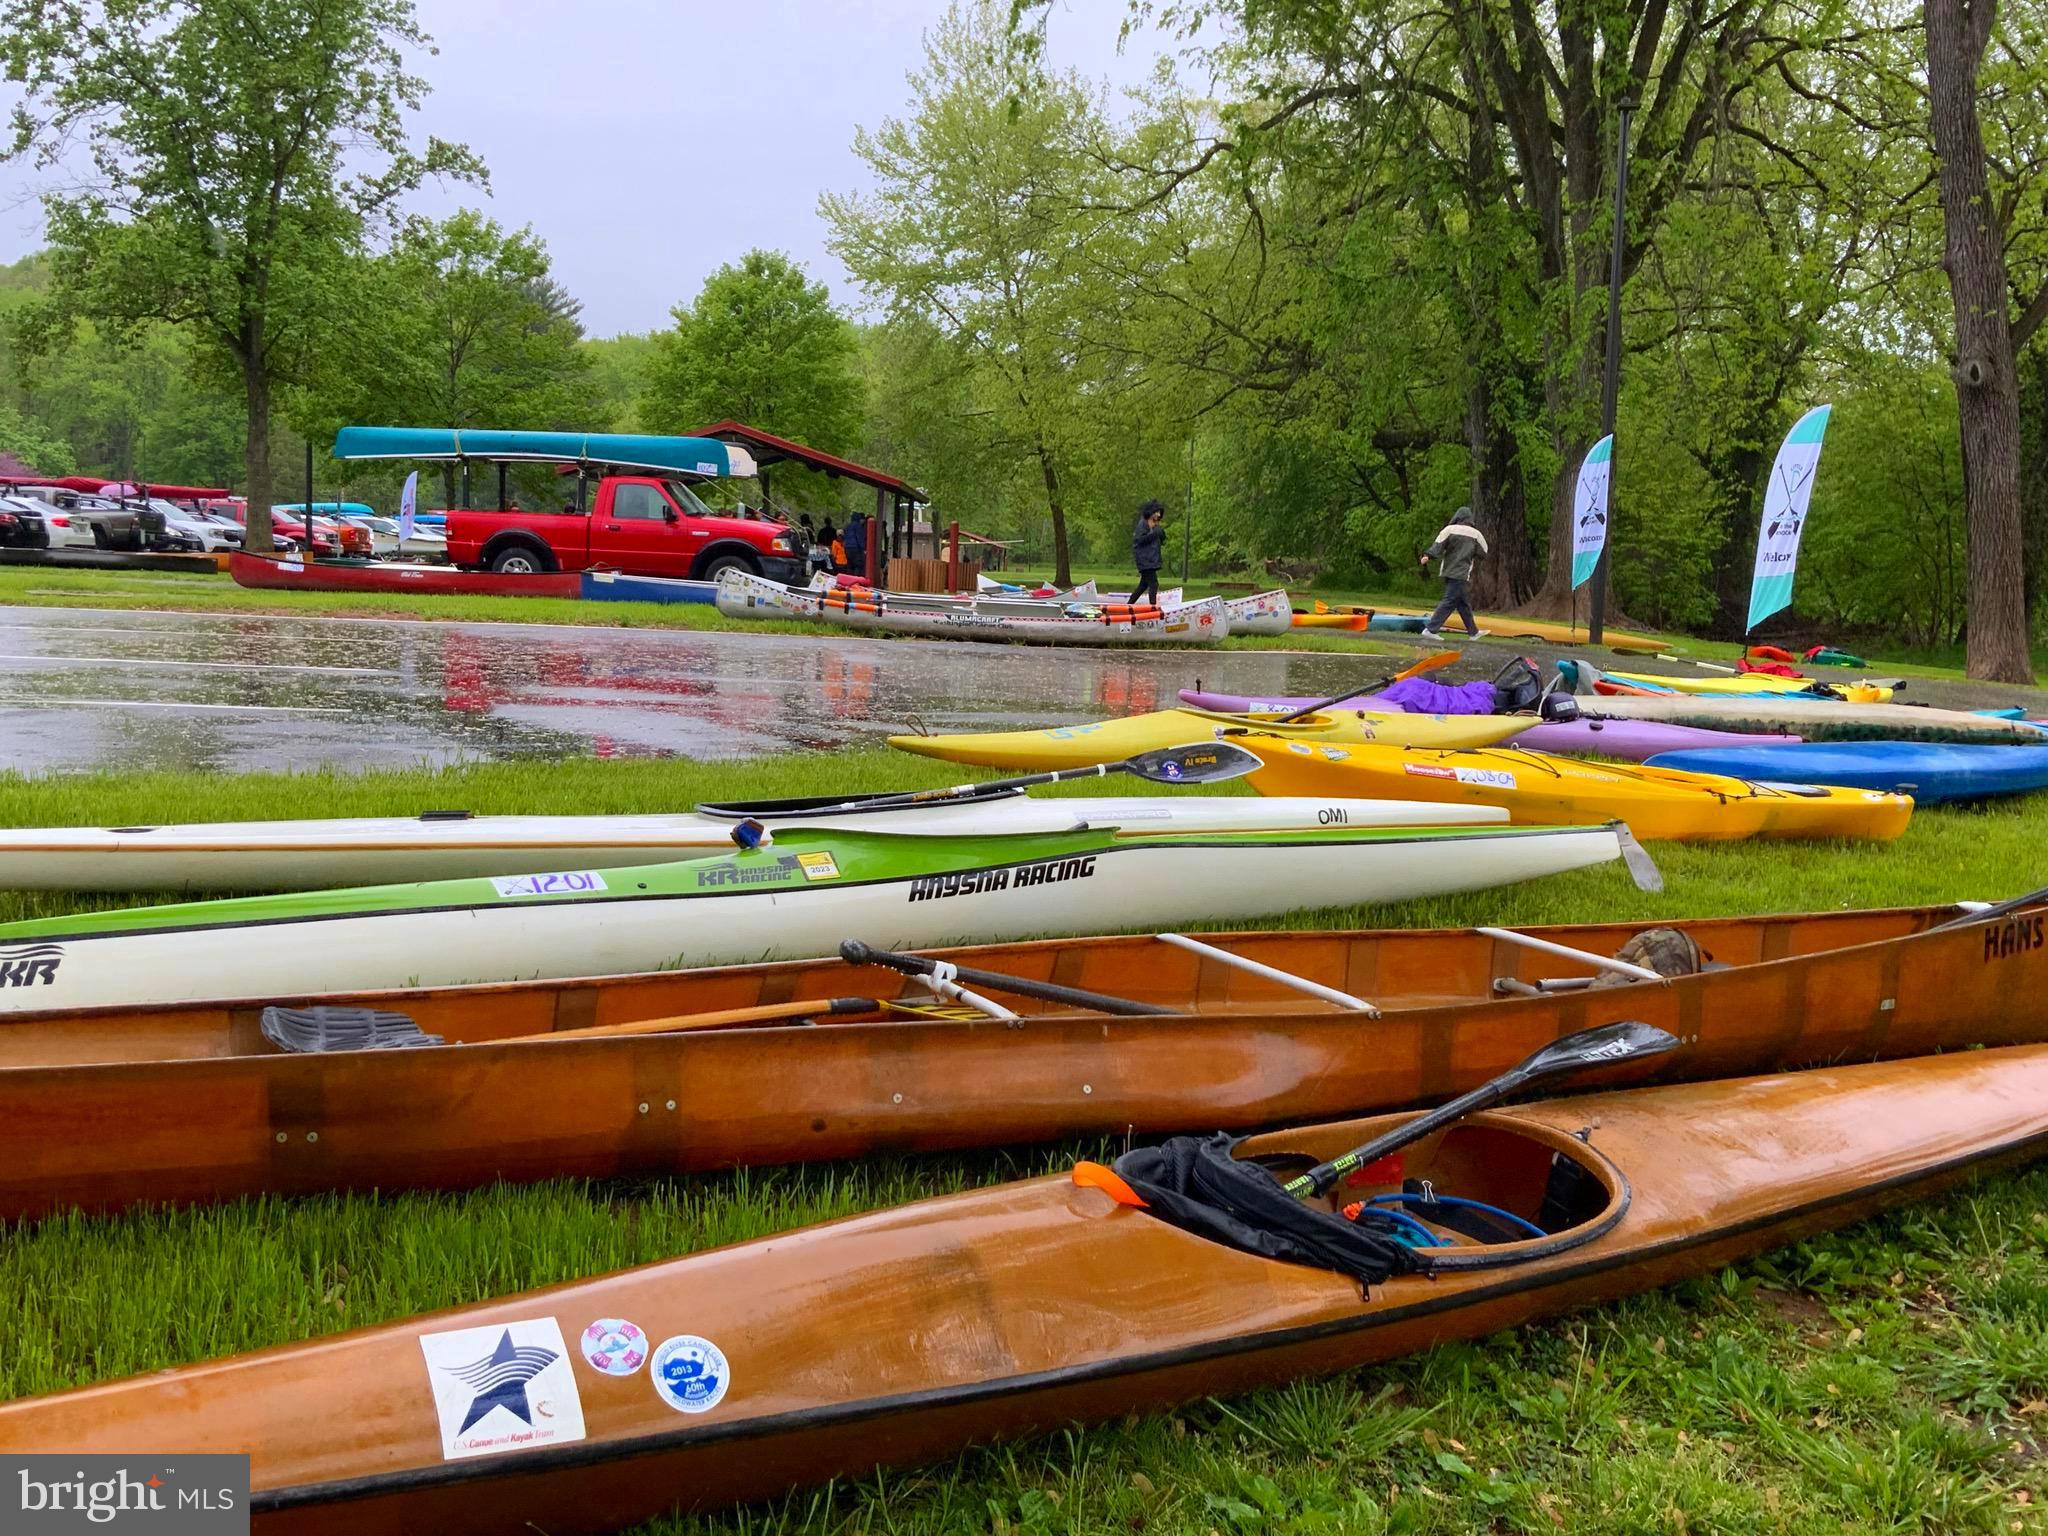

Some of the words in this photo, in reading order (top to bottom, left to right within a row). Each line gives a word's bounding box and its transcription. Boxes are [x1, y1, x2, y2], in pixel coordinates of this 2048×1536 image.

[1318, 807, 1348, 825] OMI
[698, 868, 739, 887] KR
[741, 871, 792, 885] RACING
[811, 865, 831, 874] 2023
[908, 869, 1009, 902] KNYSNA
[1013, 856, 1097, 888] RACING
[1983, 915, 2044, 964] HANS
[0, 959, 61, 988] KR
[670, 1364, 693, 1376] 2013
[685, 1382, 706, 1393] 60th
[469, 1438, 494, 1449] Canoe
[494, 1435, 510, 1445] and
[511, 1431, 533, 1443] Kayak
